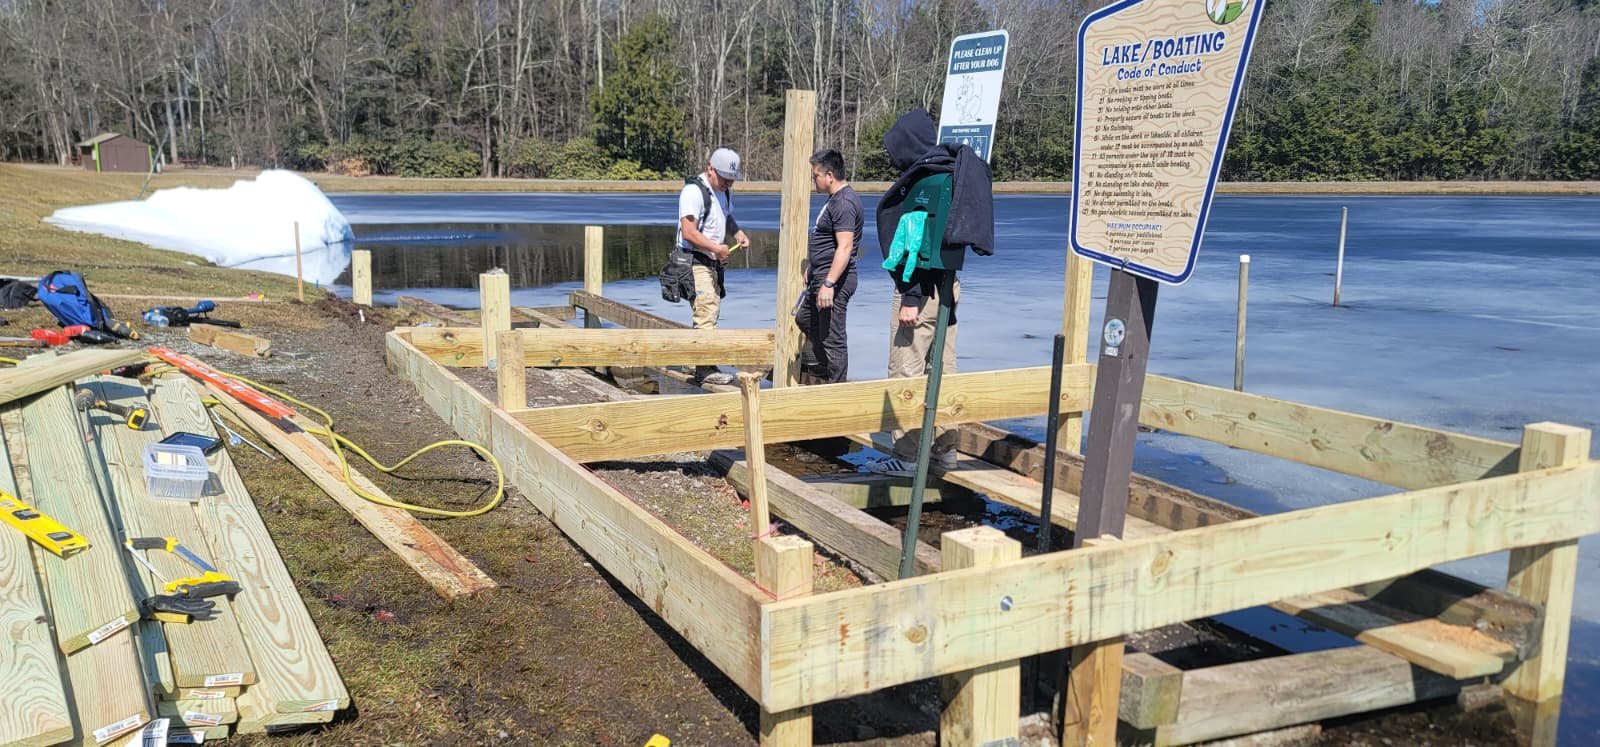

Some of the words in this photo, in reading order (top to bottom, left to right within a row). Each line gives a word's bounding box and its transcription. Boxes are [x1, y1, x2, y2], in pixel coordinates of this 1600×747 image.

[954, 49, 974, 59] PLEASE
[974, 46, 992, 56] CLEAN
[993, 45, 1002, 54] UP
[1102, 31, 1225, 66] LAKE/BOATING
[952, 61, 970, 71] AFTER
[970, 60, 986, 69] YOUR
[986, 58, 1000, 68] DOG
[1118, 66, 1142, 80] Code
[1144, 63, 1156, 78] of
[1158, 59, 1202, 76] Conduct
